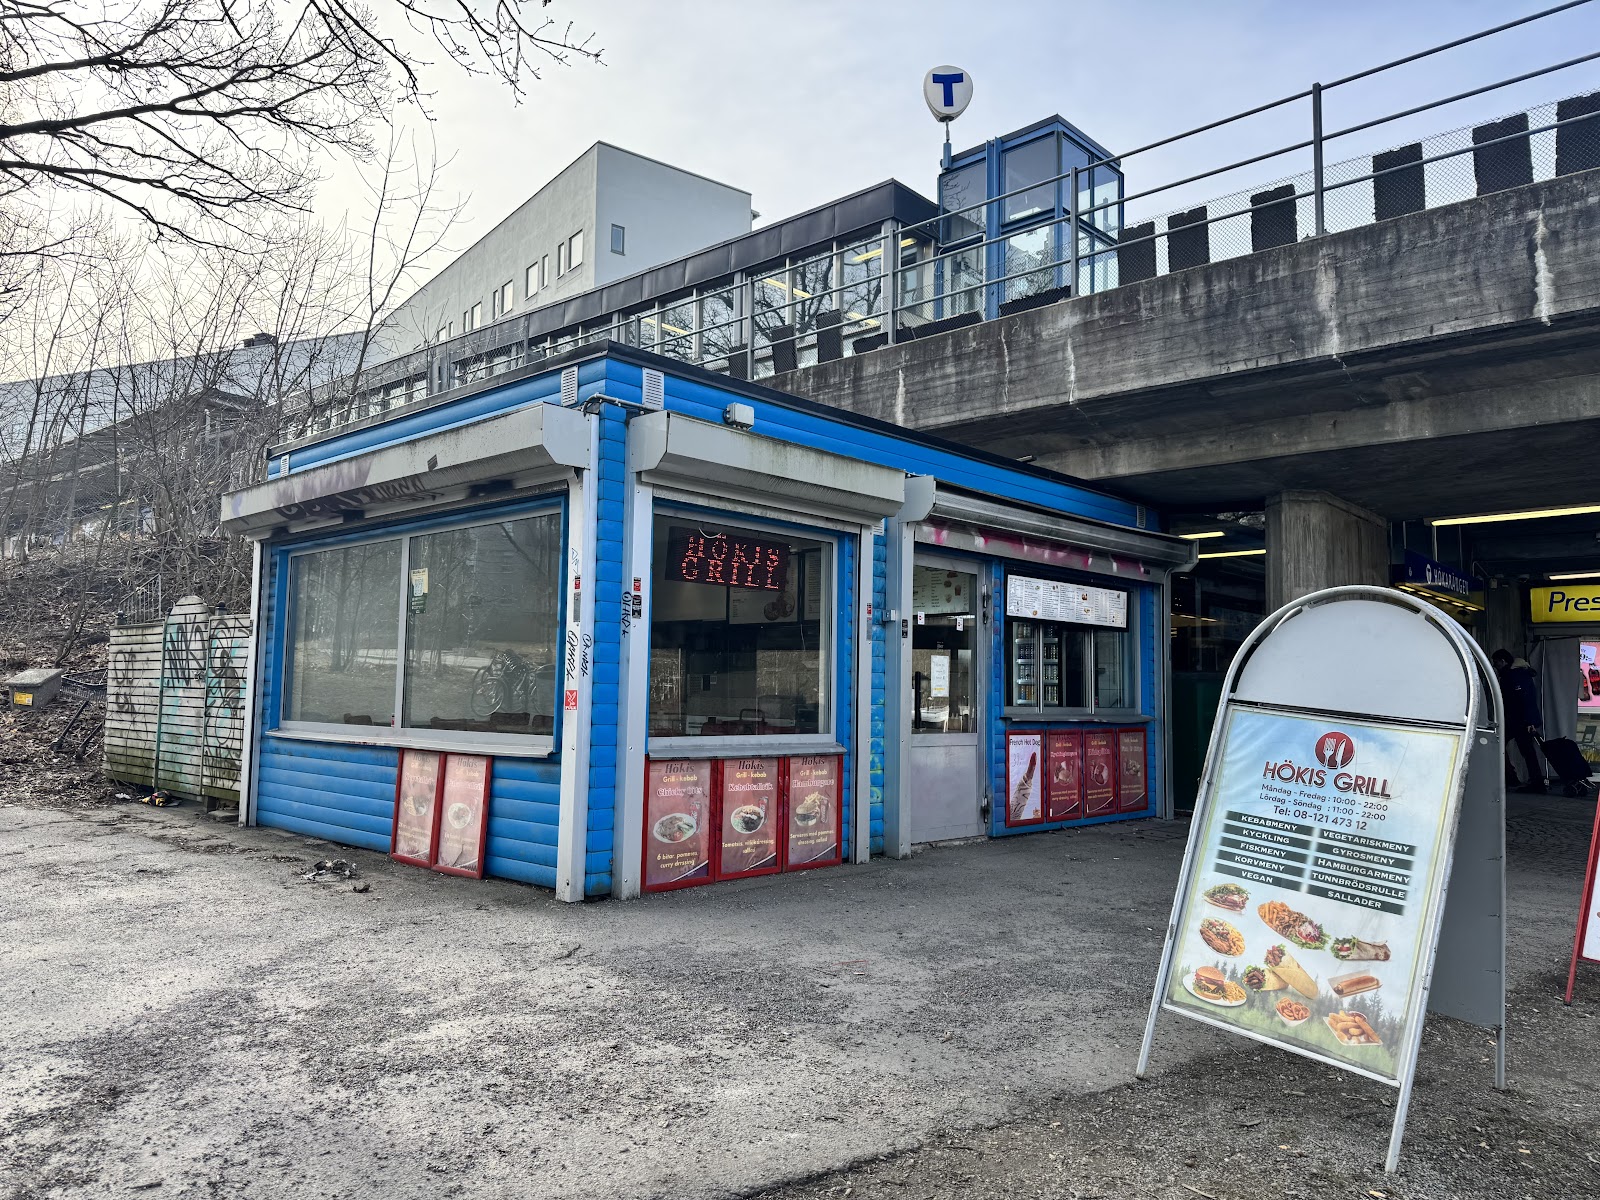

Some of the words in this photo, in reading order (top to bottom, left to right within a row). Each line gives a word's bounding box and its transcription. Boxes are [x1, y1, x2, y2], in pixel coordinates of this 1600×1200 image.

[932, 73, 963, 107] T
[682, 557, 779, 589] GRILL
[665, 762, 695, 774] Hökis
[738, 759, 765, 770] Hökis
[662, 775, 676, 783] Grill
[680, 774, 698, 782] kebab
[1262, 759, 1327, 789] HÖKIS
[1333, 772, 1392, 800] GRILL
[1261, 783, 1292, 796] Måndag
[1299, 790, 1327, 802] Fredag
[1333, 796, 1356, 806] 10:00
[1363, 801, 1388, 811] 22:00
[1259, 792, 1286, 805] Lördag
[1292, 799, 1322, 811] Söndag
[1332, 806, 1354, 816] 11:00
[1361, 811, 1386, 821] 22:00
[1241, 815, 1298, 831] KEBABMENY
[1273, 805, 1291, 816] Tel:
[1293, 809, 1329, 823] 08-121
[1331, 817, 1352, 828] 473
[1355, 820, 1368, 831] 12
[1242, 829, 1290, 844] KYCKLING
[1323, 830, 1410, 853] VEGETARISKMENY
[656, 852, 661, 861] 6
[1240, 842, 1287, 858] FISKMENY
[1332, 847, 1395, 865] GYROSMENY
[1234, 855, 1285, 872] KORVMENY
[1317, 858, 1411, 884] HAMBURGARMENY
[1241, 870, 1273, 883] VEGAN
[1312, 872, 1406, 899] TUNNBRÖDSRULLE
[1327, 890, 1382, 909] SALLADER
